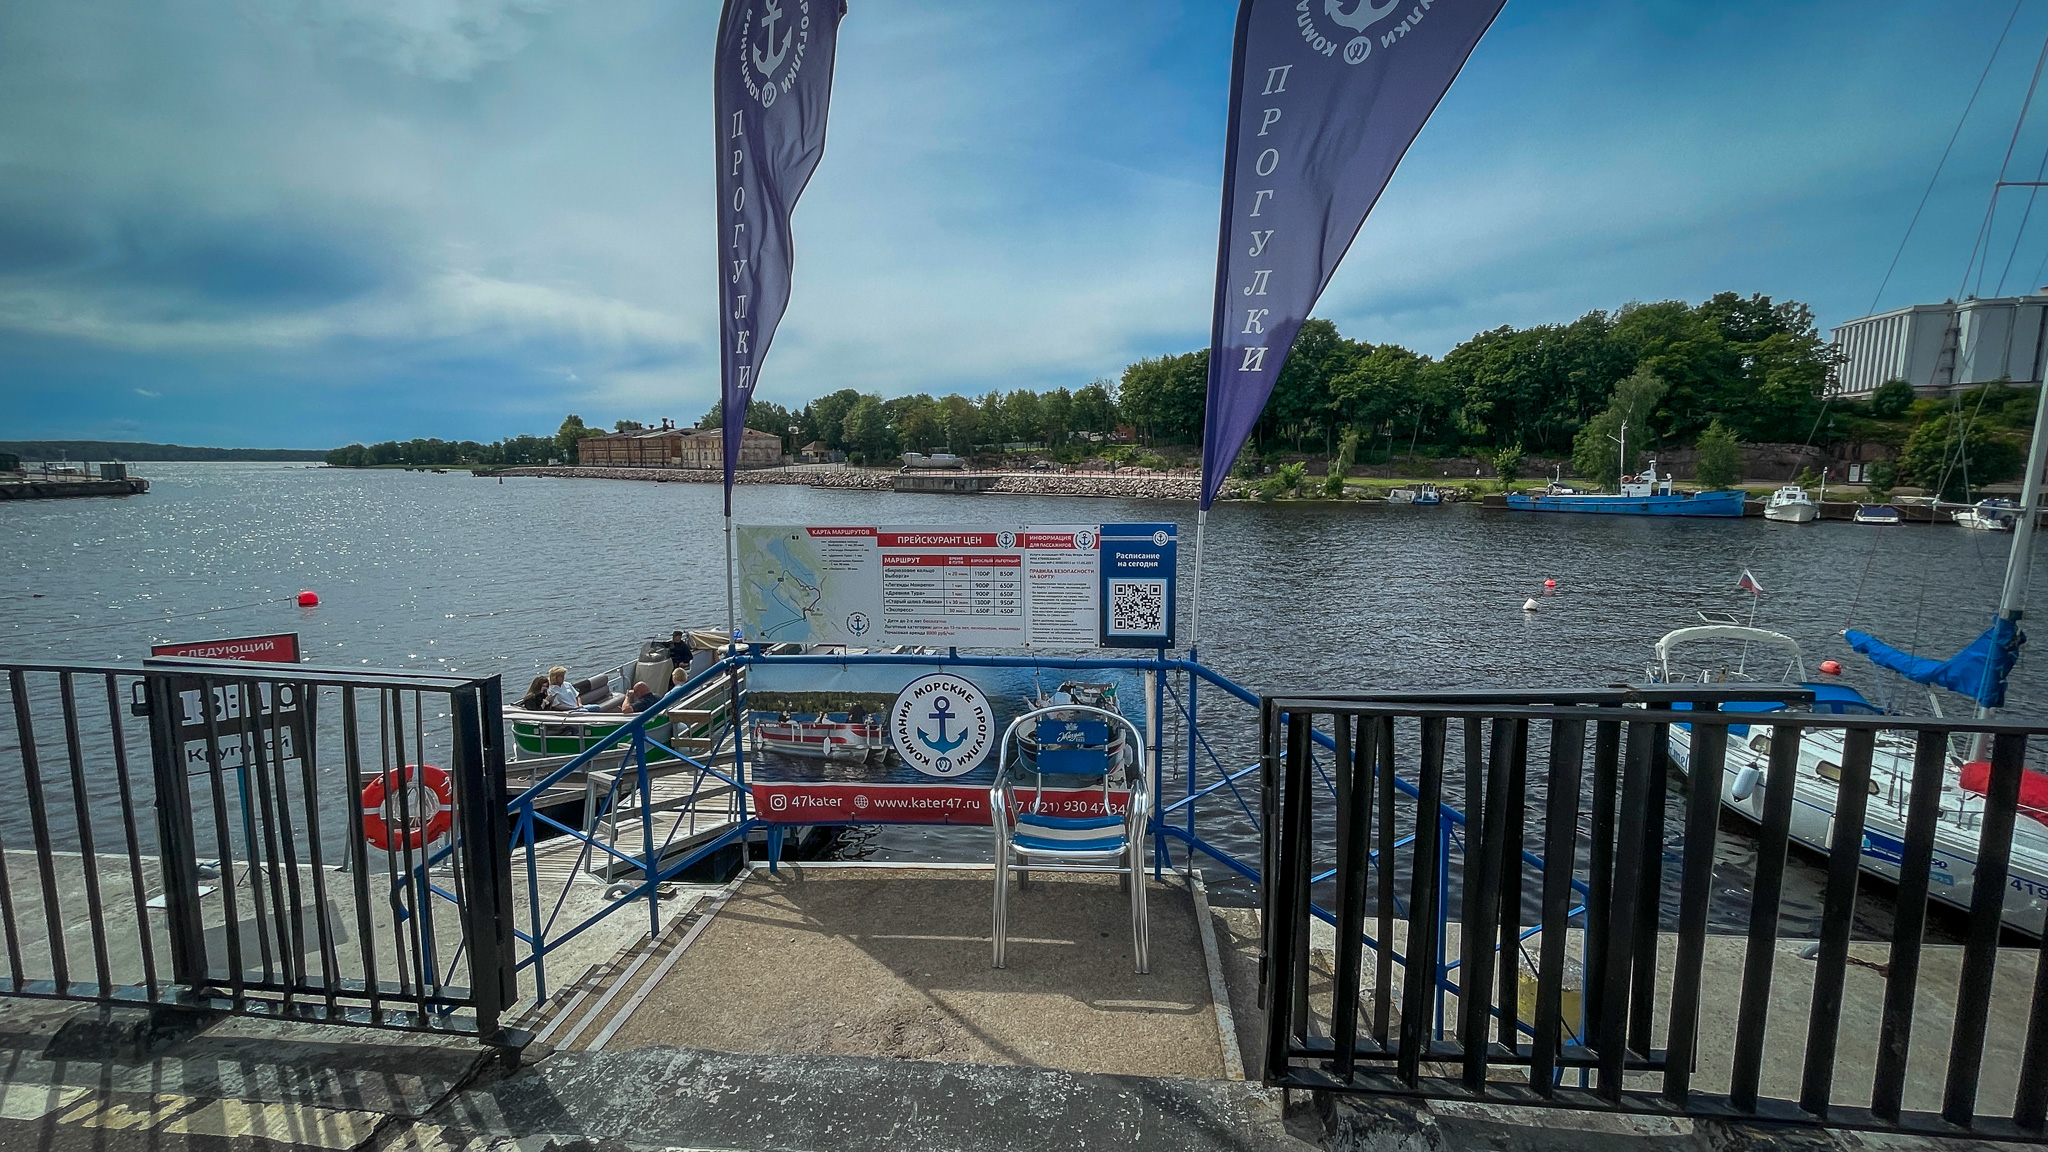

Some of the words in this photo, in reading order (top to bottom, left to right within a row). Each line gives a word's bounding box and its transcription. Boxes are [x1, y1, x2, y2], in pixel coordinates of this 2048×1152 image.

[741, 8, 760, 101] КОМПАНИЯ
[781, 0, 810, 94] РОГУЛКИ
[1238, 64, 1293, 372] ПРОГУЛКИ
[731, 109, 751, 390] ПРОГУЛКИ
[897, 535, 961, 544] ПРЕЙСКУРАНТ
[963, 536, 982, 545] ЦЕН
[177, 640, 274, 657] СЛЕДУЮЩИЙ
[913, 682, 975, 703] МОРСКИЕ
[898, 700, 931, 766] КОМПАНИЯ
[956, 706, 987, 766] ПРОГУЛКИ
[791, 795, 843, 807] 47kater
[874, 797, 980, 809] www.kater47.ru
[1063, 801, 1087, 813] 930
[1090, 802, 1106, 813] 47
[1110, 803, 1126, 815] 34
